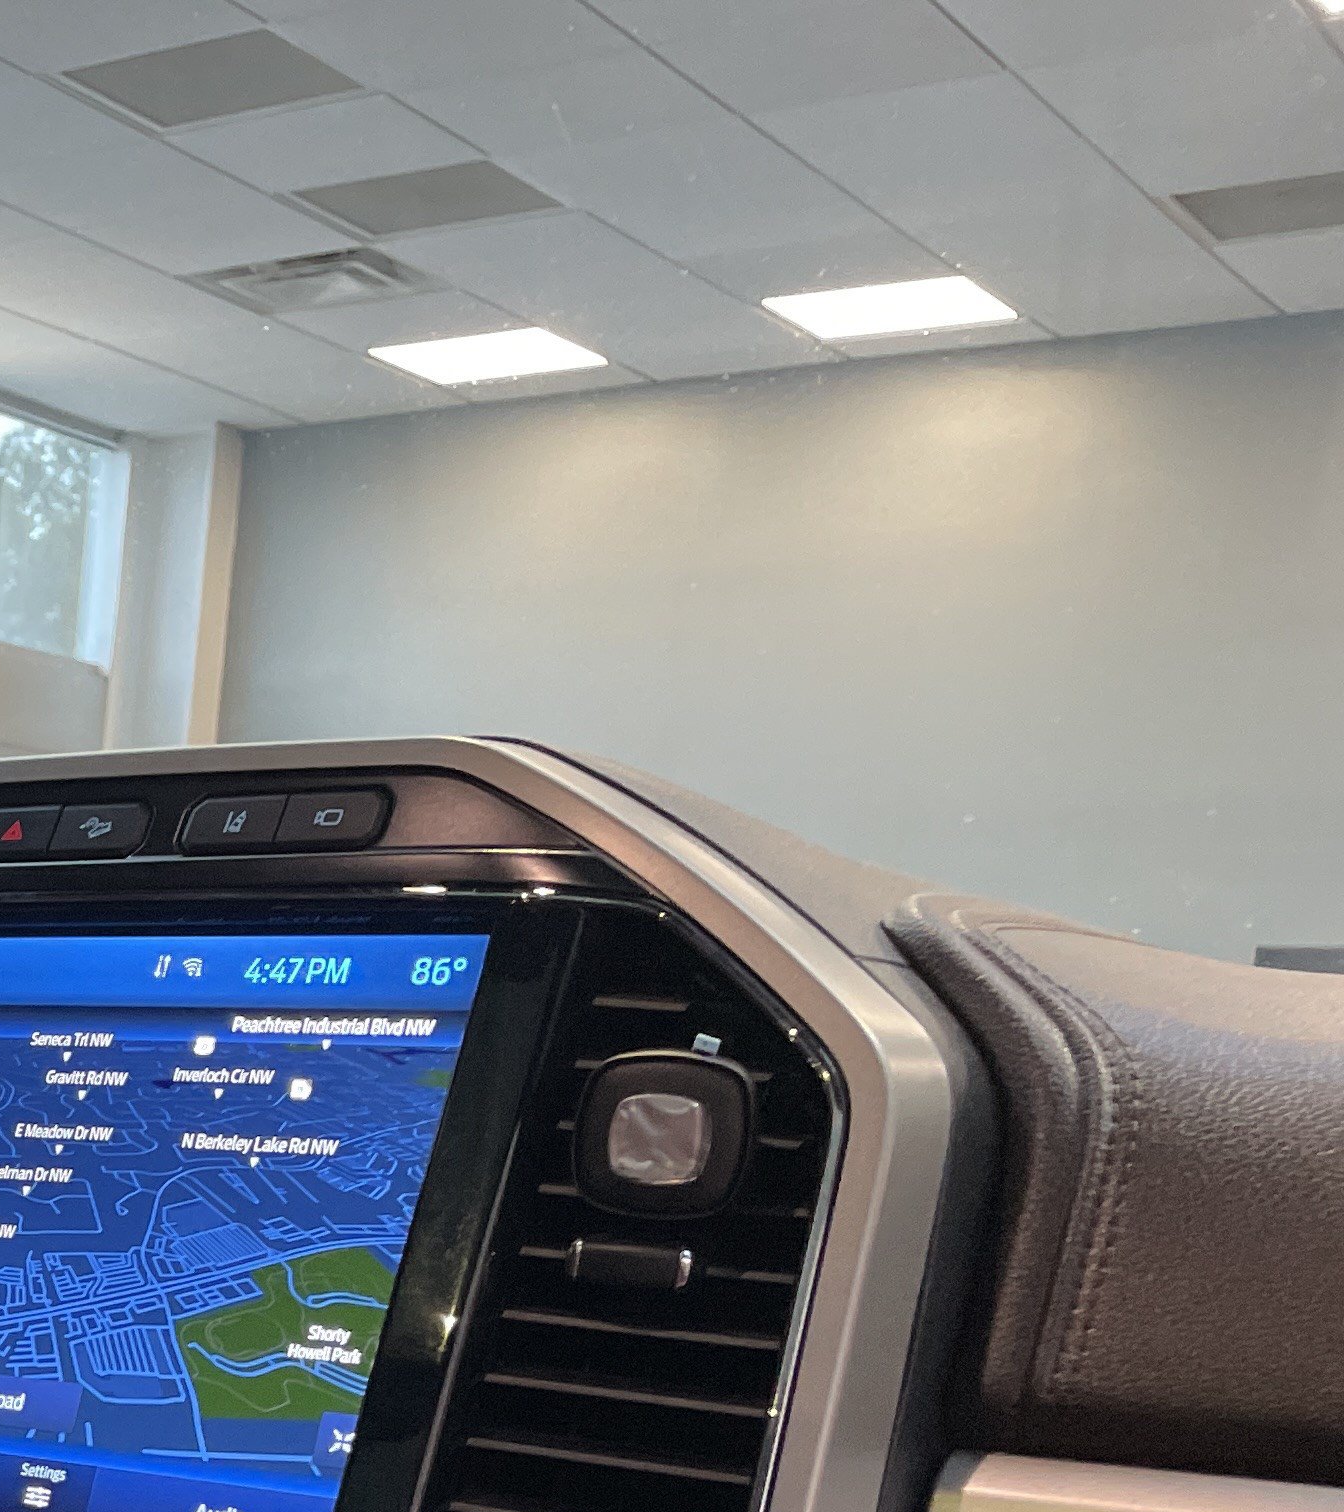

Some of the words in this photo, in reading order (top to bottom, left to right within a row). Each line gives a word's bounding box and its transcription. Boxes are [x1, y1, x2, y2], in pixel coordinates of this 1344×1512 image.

[244, 957, 301, 984] 4:47
[305, 957, 352, 984] PM
[411, 957, 468, 986] 86°
[232, 1016, 300, 1034] Peachtree
[302, 1017, 368, 1035] Industrial
[370, 1018, 405, 1035] Blvd
[405, 1019, 437, 1036] NW
[30, 1032, 71, 1047] Seneca
[73, 1032, 88, 1047] Trl
[87, 1033, 114, 1047] NW
[45, 1070, 85, 1085] Gravitt
[86, 1071, 103, 1086] Rd
[103, 1072, 128, 1086] NW
[173, 1067, 229, 1083] Inverloch
[230, 1069, 248, 1084] Cir
[248, 1070, 275, 1085] NW
[15, 1123, 24, 1138] E
[25, 1124, 74, 1140] Meadow
[74, 1126, 90, 1141] Dr
[89, 1127, 114, 1141] NW
[182, 1133, 194, 1148] N
[195, 1133, 253, 1153] Berkeley
[253, 1136, 289, 1153] Lake
[290, 1138, 310, 1154] Rd
[310, 1140, 340, 1156] NW
[34, 1167, 49, 1181] Dr
[48, 1168, 73, 1182] NW
[307, 1325, 352, 1345] Shorty
[287, 1343, 330, 1363] Howell
[331, 1346, 362, 1365] Park
[20, 1462, 67, 1482] Settings
